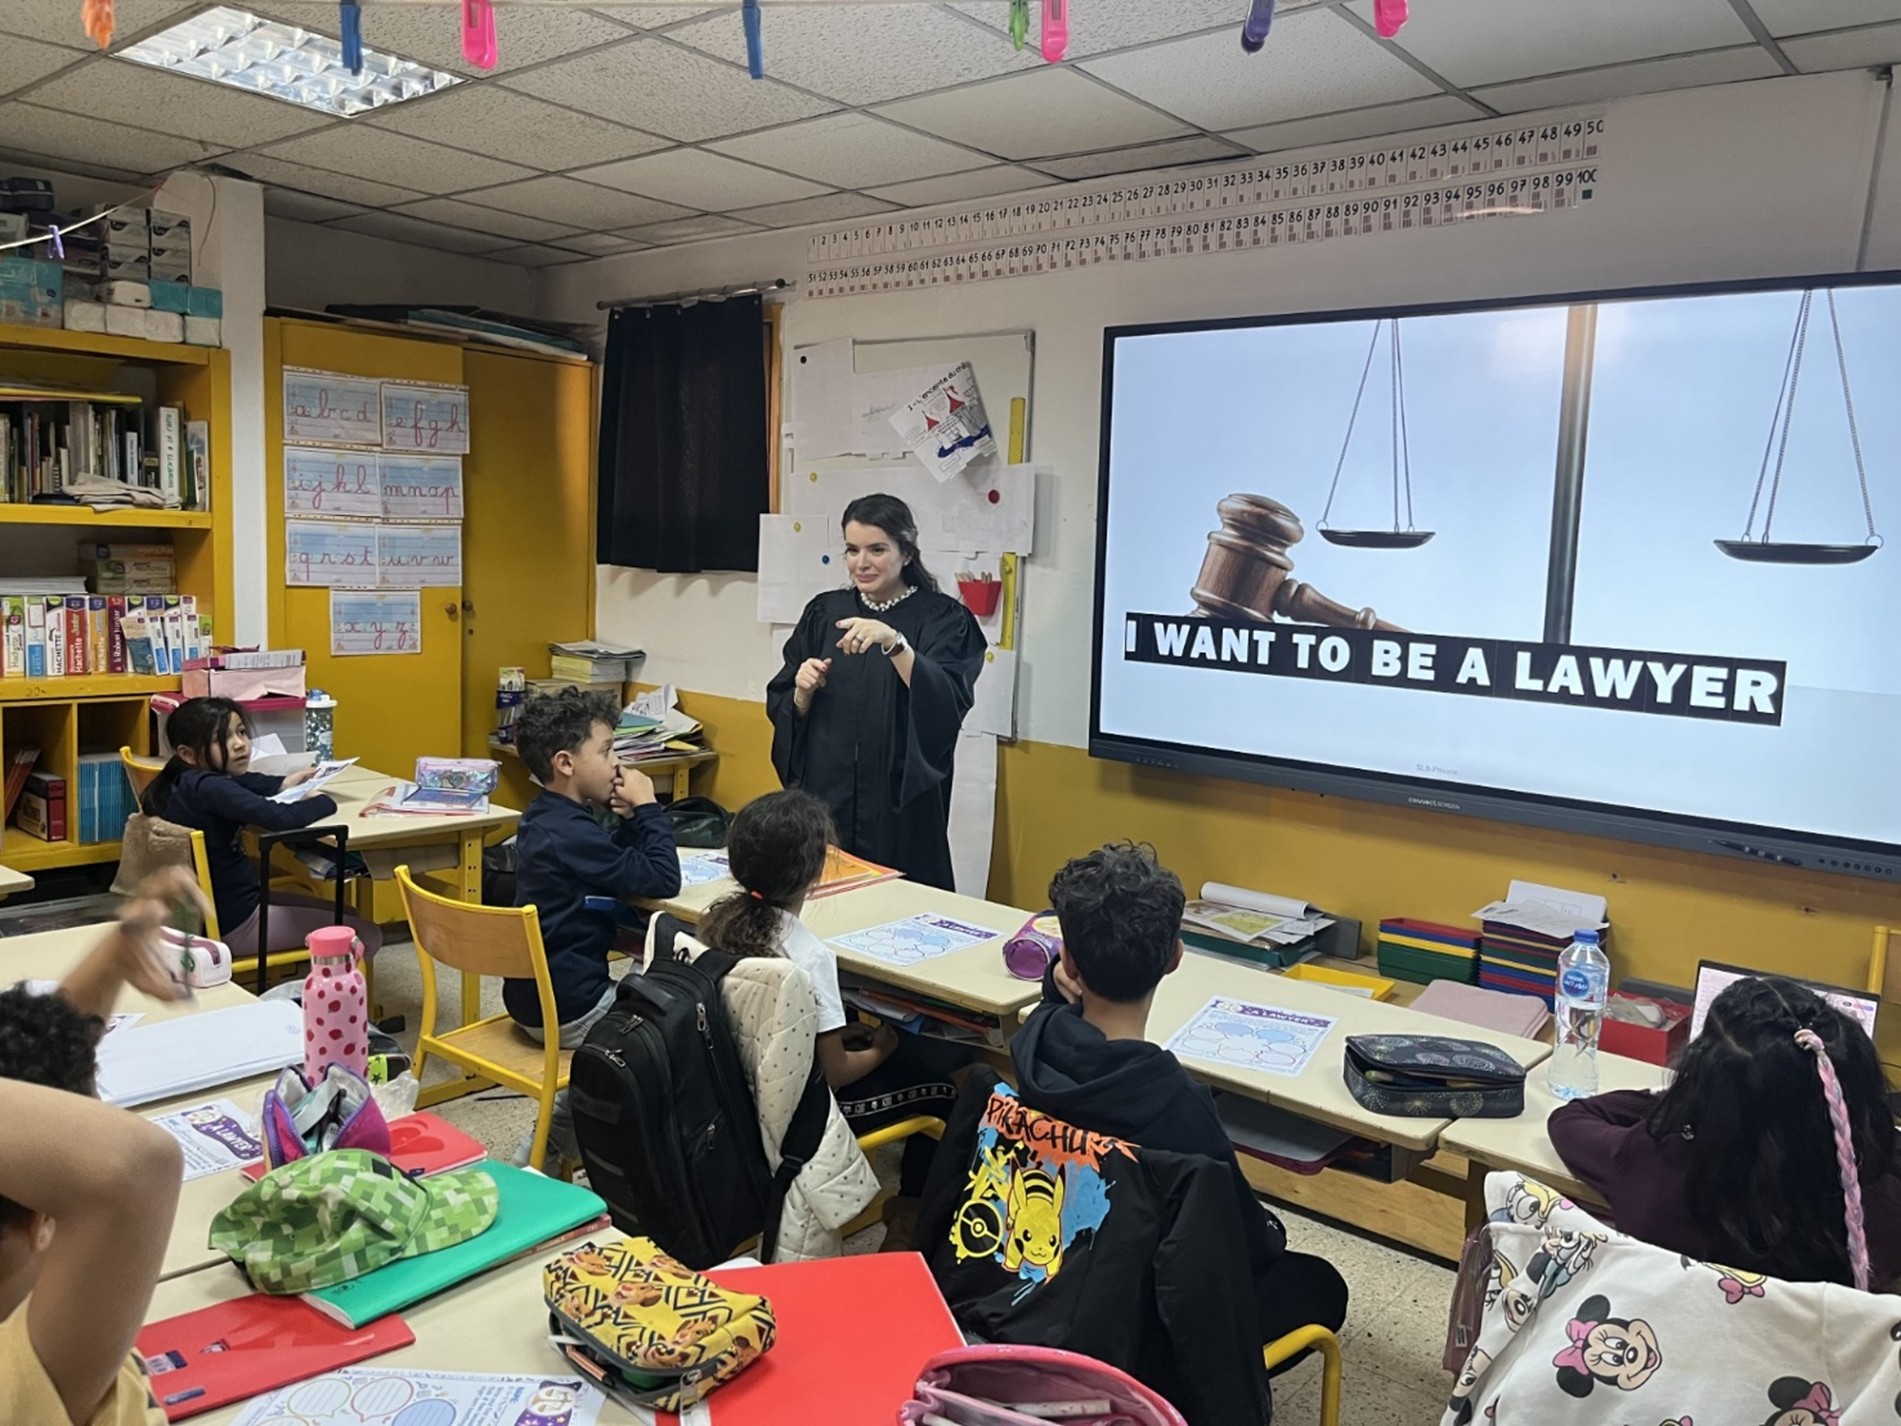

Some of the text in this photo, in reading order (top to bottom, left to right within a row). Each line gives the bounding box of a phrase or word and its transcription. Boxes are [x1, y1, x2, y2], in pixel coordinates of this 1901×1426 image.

[808, 273, 816, 283] 51
[818, 271, 827, 282] 52
[829, 271, 838, 281] 53
[840, 269, 848, 279] 54
[851, 268, 859, 278] 55
[861, 267, 870, 277] 56
[873, 265, 882, 276] 57
[884, 264, 894, 274] 58
[896, 263, 906, 273] 59
[908, 262, 918, 272] 60
[920, 260, 929, 270] 61
[932, 258, 941, 269] 62
[944, 256, 954, 267] 63
[956, 256, 965, 265] 64
[969, 253, 978, 263] 65
[982, 251, 992, 262] 66
[996, 249, 1005, 260] 67
[1009, 247, 1018, 258] 68
[1022, 245, 1033, 257] 69
[1036, 243, 1046, 254] 70
[1052, 242, 1060, 252] 71
[1066, 240, 1075, 250] 72
[1080, 238, 1090, 248] 73
[1095, 236, 1105, 246] 74
[1110, 234, 1119, 245] 75
[1125, 232, 1135, 242] 76
[1140, 230, 1150, 241] 77
[1156, 228, 1166, 239] 78
[1171, 226, 1182, 237] 79
[1186, 224, 1199, 235] 80
[1203, 222, 1214, 234] 81
[1220, 220, 1232, 231] 82
[1236, 217, 1249, 229] 83
[1254, 216, 1266, 227] 84
[1272, 213, 1284, 225] 85
[1289, 210, 1302, 223] 86
[1308, 208, 1320, 221] 87
[1326, 206, 1339, 219] 88
[1344, 203, 1358, 217] 89
[1363, 201, 1379, 214] 90
[1384, 198, 1397, 211] 91
[1404, 195, 1419, 208] 92
[1424, 192, 1439, 205] 93
[1445, 189, 1460, 203] 94
[1467, 185, 1482, 200] 95
[1488, 182, 1504, 196] 96
[1511, 179, 1526, 193] 97
[1533, 176, 1549, 190] 98
[1556, 172, 1573, 187] 99
[821, 235, 826, 246] 2
[832, 233, 837, 244] 3
[842, 232, 848, 242] 4
[854, 230, 859, 241] 5
[865, 229, 870, 239] 6
[877, 227, 882, 236] 7
[888, 225, 893, 236] 8
[899, 223, 905, 234] 9
[910, 221, 919, 231] 10
[922, 220, 930, 230] 11
[934, 218, 943, 228] 12
[947, 216, 956, 227] 13
[960, 215, 968, 224] 14
[973, 212, 981, 223] 15
[986, 211, 994, 221] 16
[999, 208, 1007, 219] 17
[1012, 206, 1021, 217] 18
[1026, 204, 1035, 215] 19
[1039, 202, 1050, 213] 20
[1054, 200, 1063, 211] 21
[1068, 198, 1078, 209] 22
[1082, 195, 1093, 207] 23
[1097, 194, 1108, 205] 24
[1112, 191, 1123, 203] 25
[1127, 189, 1138, 201] 26
[1143, 186, 1154, 199] 27
[1158, 184, 1170, 196] 28
[1174, 182, 1186, 194] 29
[1190, 179, 1202, 192] 30
[1207, 178, 1218, 190] 31
[1224, 175, 1236, 187] 32
[1240, 172, 1253, 184] 33
[1258, 170, 1270, 182] 34
[1276, 167, 1288, 180] 35
[1293, 164, 1307, 177] 36
[1312, 161, 1326, 175] 37
[1331, 159, 1345, 172] 38
[1350, 156, 1364, 170] 39
[1369, 153, 1385, 166] 40
[1390, 150, 1403, 162] 41
[1410, 147, 1425, 160] 42
[1431, 143, 1446, 157] 43
[1452, 141, 1468, 153] 44
[1474, 137, 1489, 150] 45
[1496, 133, 1512, 147] 46
[1518, 130, 1534, 144] 47
[1541, 126, 1557, 141] 48
[1564, 123, 1581, 137] 49
[74, 638, 82, 673] Hachette
[1126, 620, 1778, 714] I WANT TO BE A LAWYER
